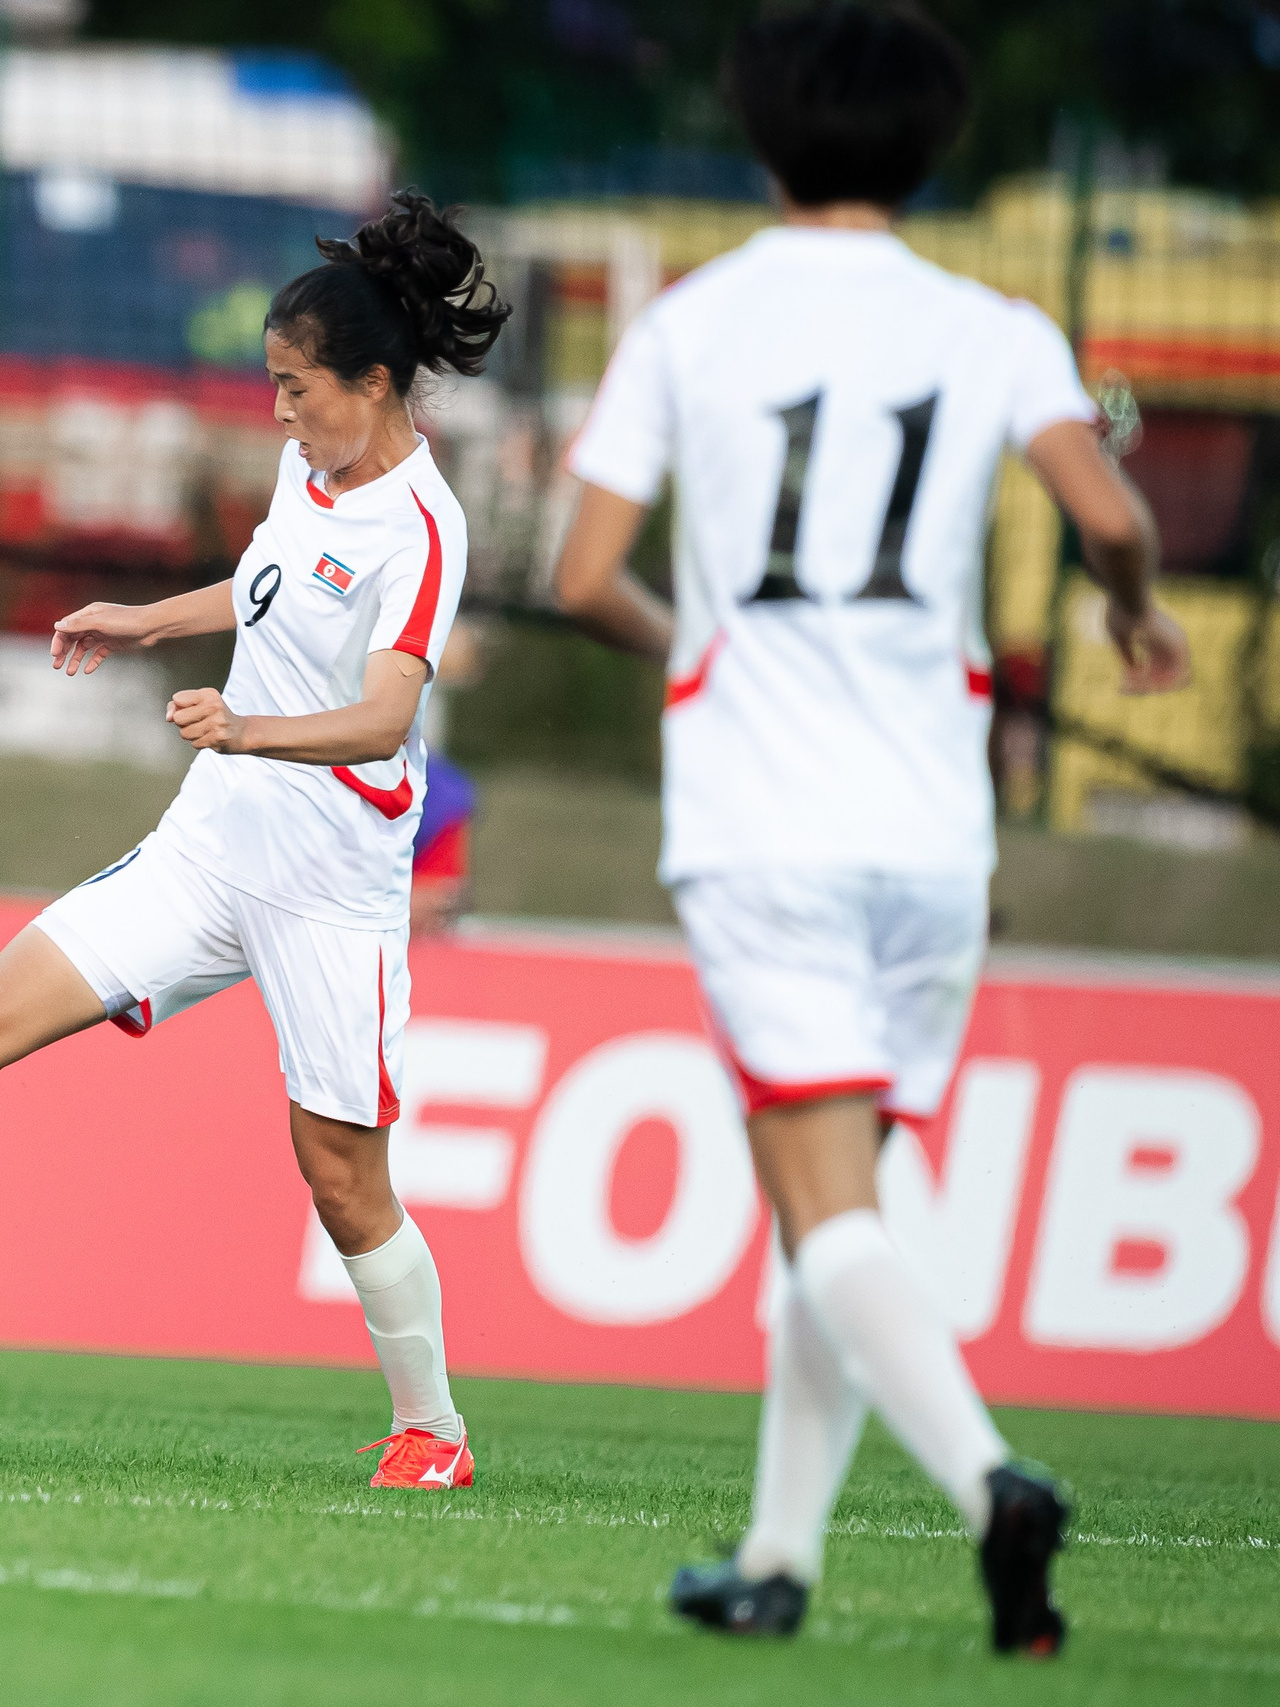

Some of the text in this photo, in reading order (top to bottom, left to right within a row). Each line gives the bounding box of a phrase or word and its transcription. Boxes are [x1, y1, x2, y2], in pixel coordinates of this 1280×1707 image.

[245, 564, 282, 627] 9
[734, 383, 942, 607] 11
[295, 1018, 1280, 1354] FONB
